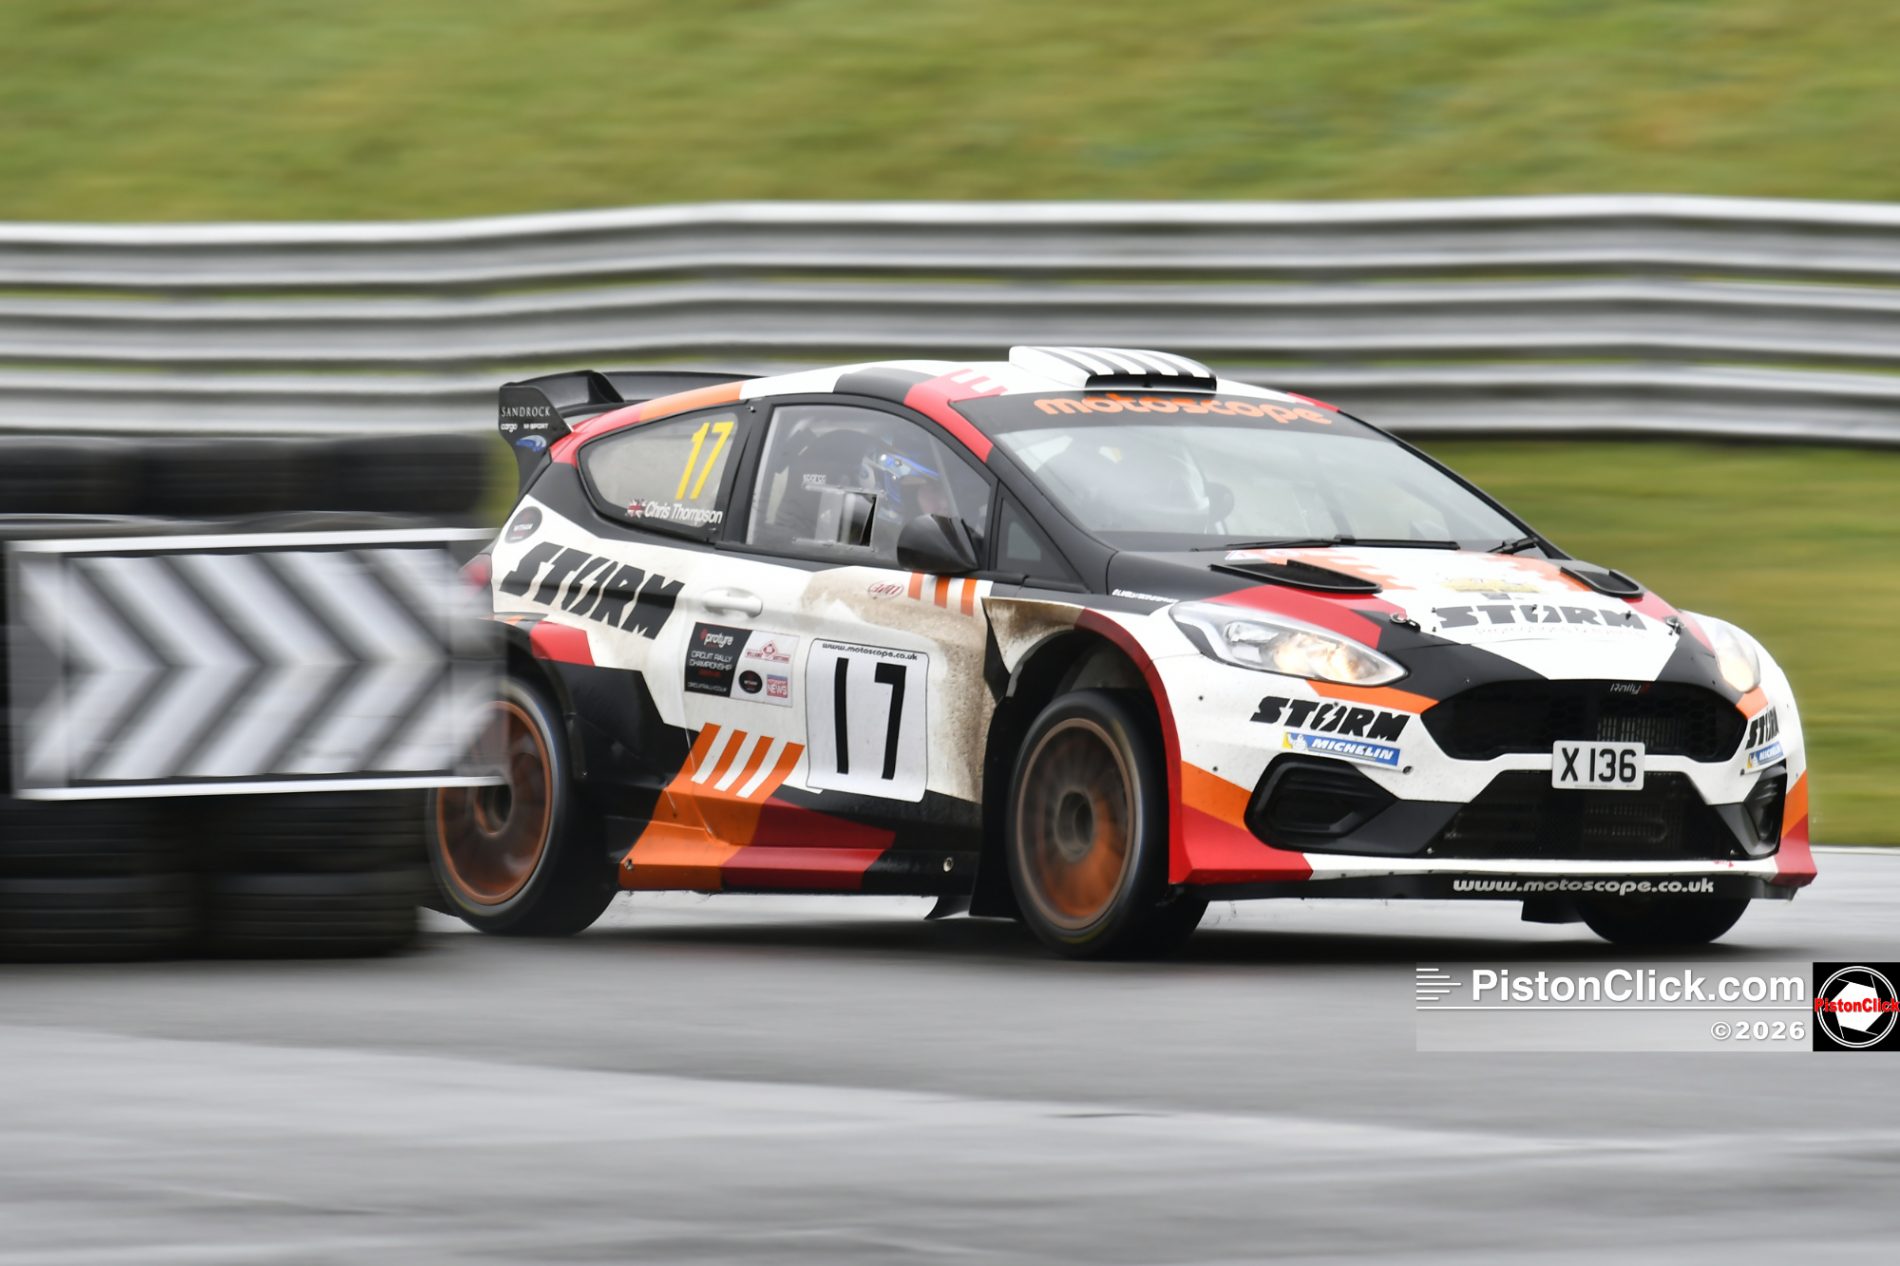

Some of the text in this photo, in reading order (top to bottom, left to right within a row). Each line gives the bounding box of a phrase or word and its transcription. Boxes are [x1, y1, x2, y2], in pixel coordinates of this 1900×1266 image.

[501, 406, 550, 417] SANDROCK
[1034, 393, 1332, 425] motoscope
[675, 421, 735, 501] 17
[644, 500, 723, 526] Chris Thompson
[822, 642, 918, 661] www.motoscope.co.uk
[834, 657, 907, 781] 17
[1312, 738, 1394, 760] MICHELIN
[1560, 747, 1637, 783] X 136
[1453, 878, 1714, 896] www.motoscope.co.uk
